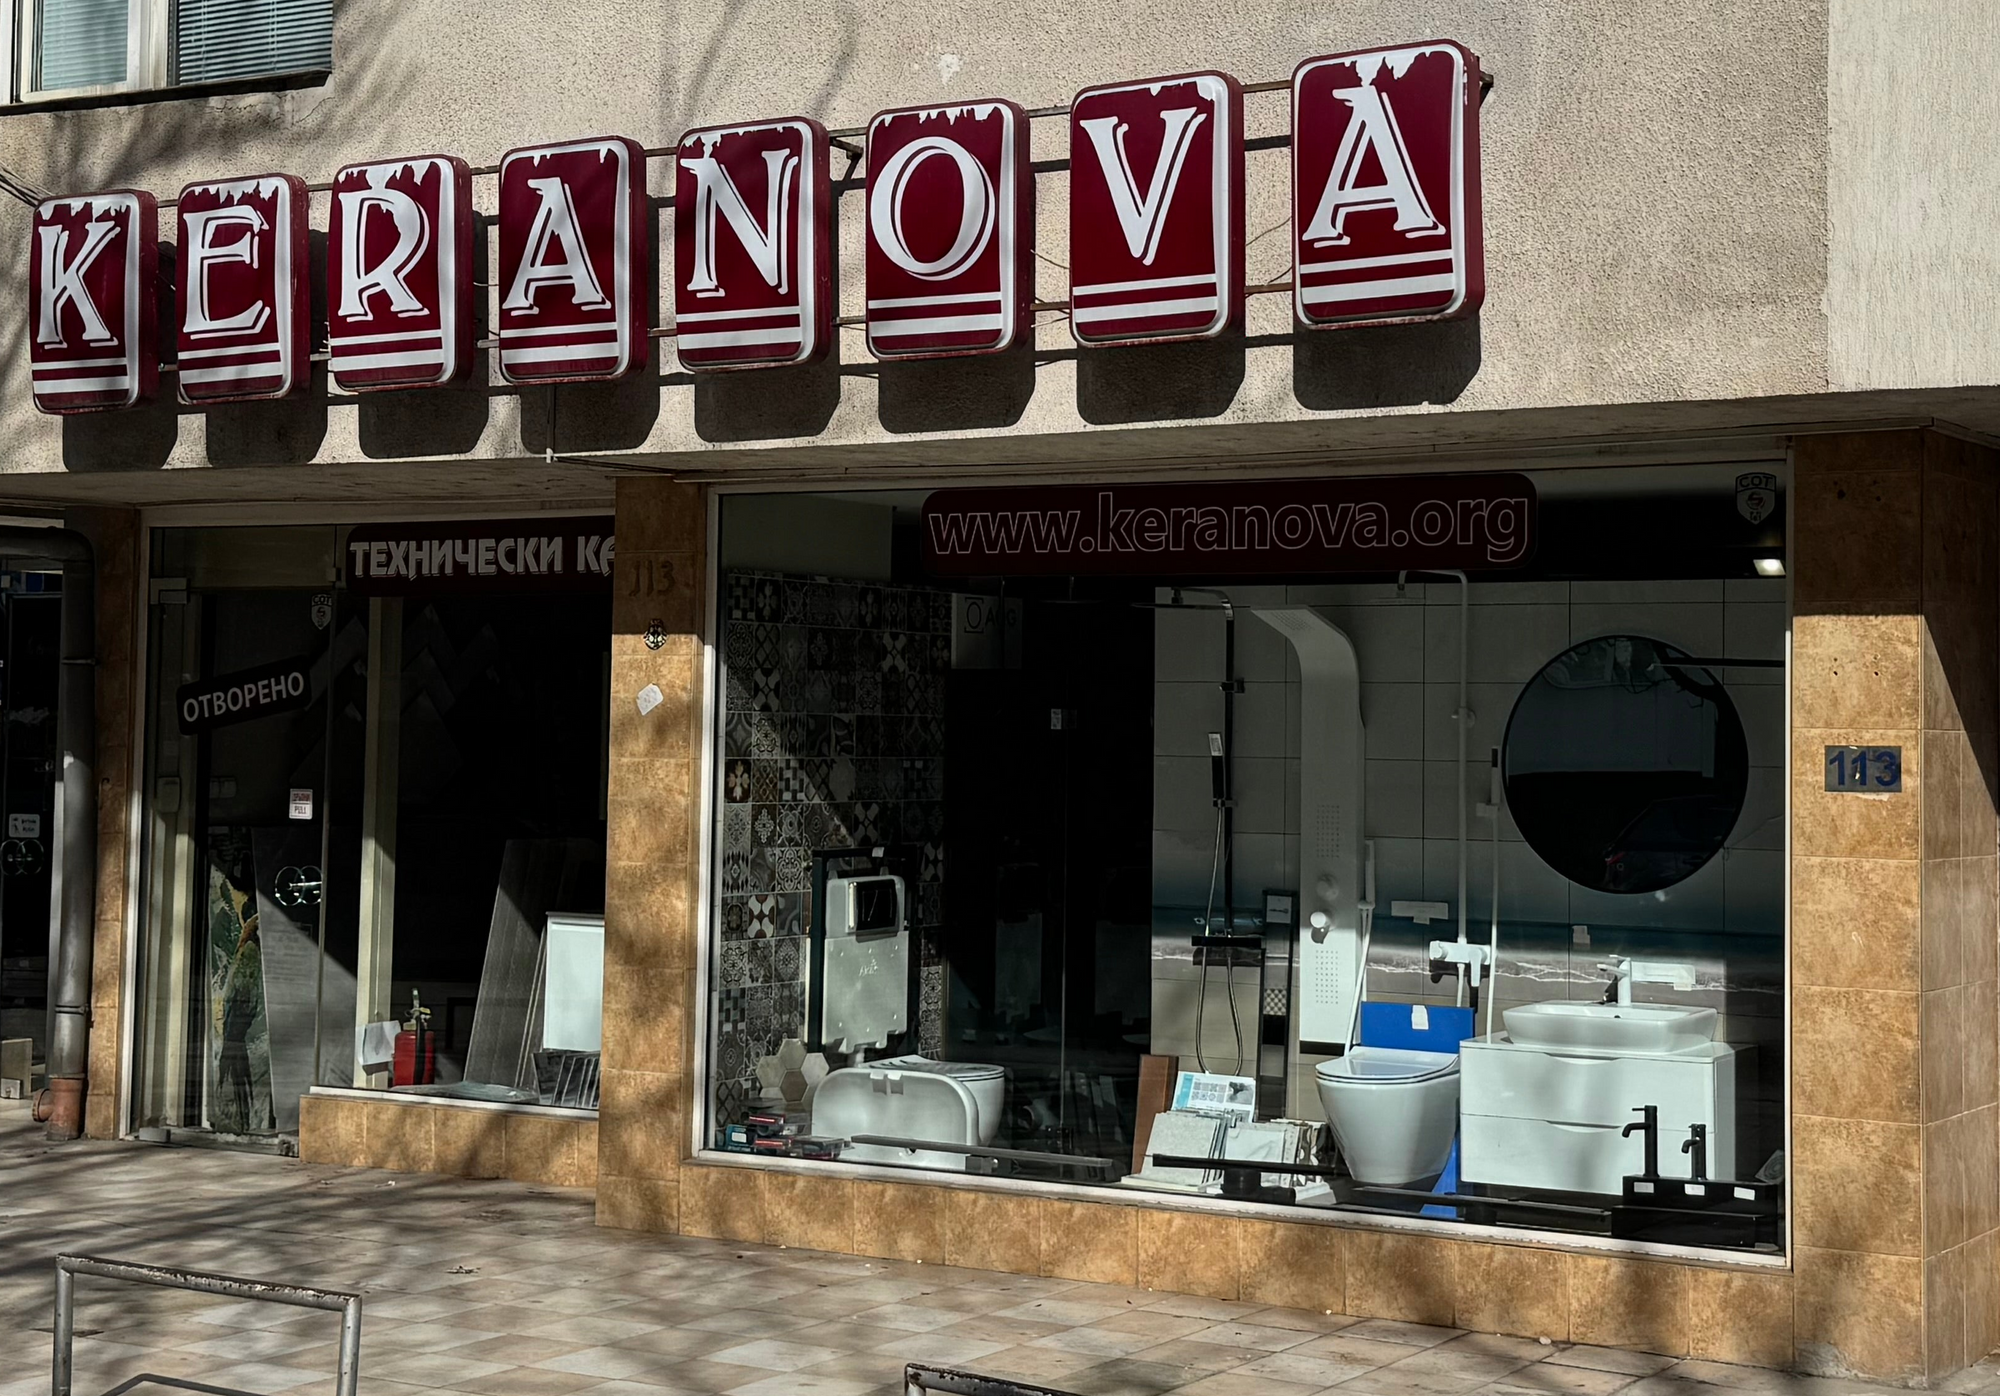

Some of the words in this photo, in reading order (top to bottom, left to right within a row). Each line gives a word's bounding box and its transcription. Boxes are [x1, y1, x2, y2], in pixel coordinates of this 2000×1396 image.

[37, 84, 1447, 350] KERANOVA
[928, 491, 1529, 562] www.keranova.org
[349, 536, 564, 581] ТЕХНИЧЕСКИ
[183, 671, 305, 722] ОТВОРЕНО
[1828, 750, 1899, 787] 113
